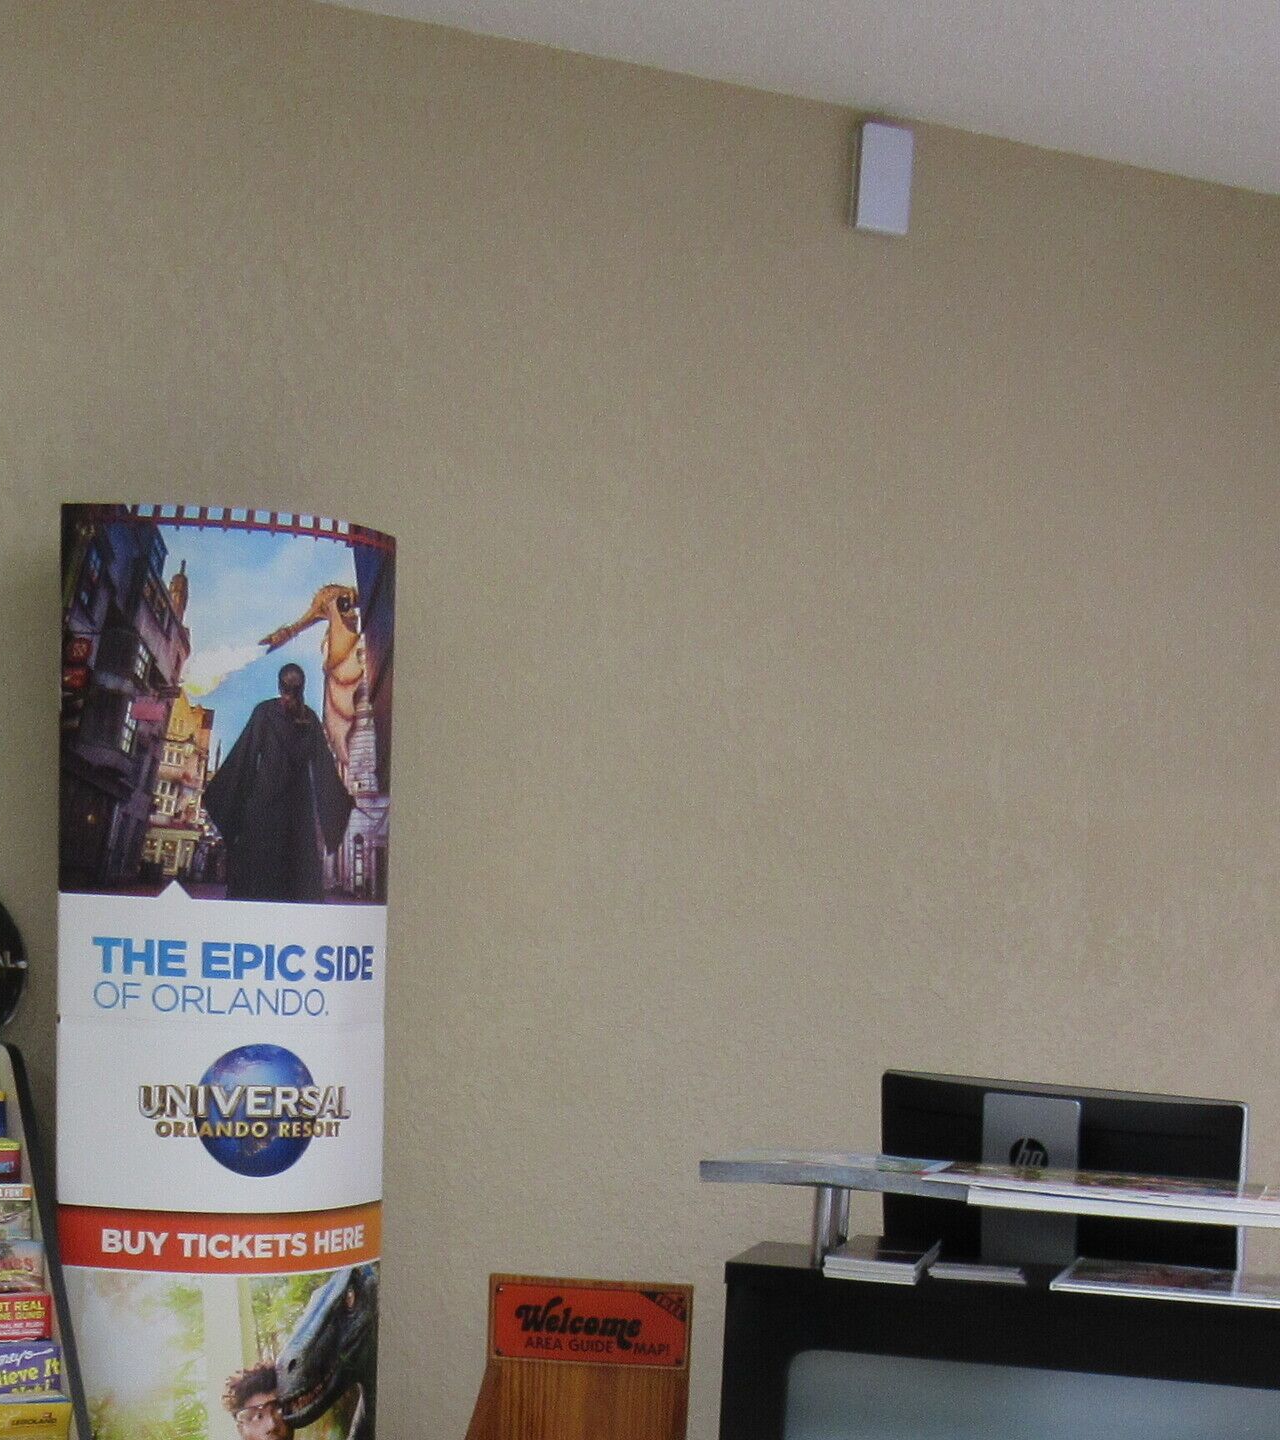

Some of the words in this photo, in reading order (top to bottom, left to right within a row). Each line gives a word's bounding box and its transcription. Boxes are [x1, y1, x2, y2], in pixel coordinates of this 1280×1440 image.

[92, 936, 187, 977] THE
[201, 941, 306, 982] EPIC
[314, 945, 374, 982] SIDE
[93, 980, 141, 1010] OF
[151, 984, 330, 1017] ORLANDO.
[138, 1084, 352, 1119] UNIVERSAL
[154, 1120, 269, 1139] ORLANDO
[277, 1120, 341, 1139] RESORT
[101, 1229, 168, 1256] BUY
[177, 1232, 308, 1259] TICKETS
[313, 1224, 365, 1255] HERE
[14, 1300, 45, 1311] REAL
[515, 1296, 643, 1350] Welcome
[524, 1336, 563, 1350] AREA
[568, 1338, 615, 1353] GUIDE
[43, 1359, 62, 1378] It
